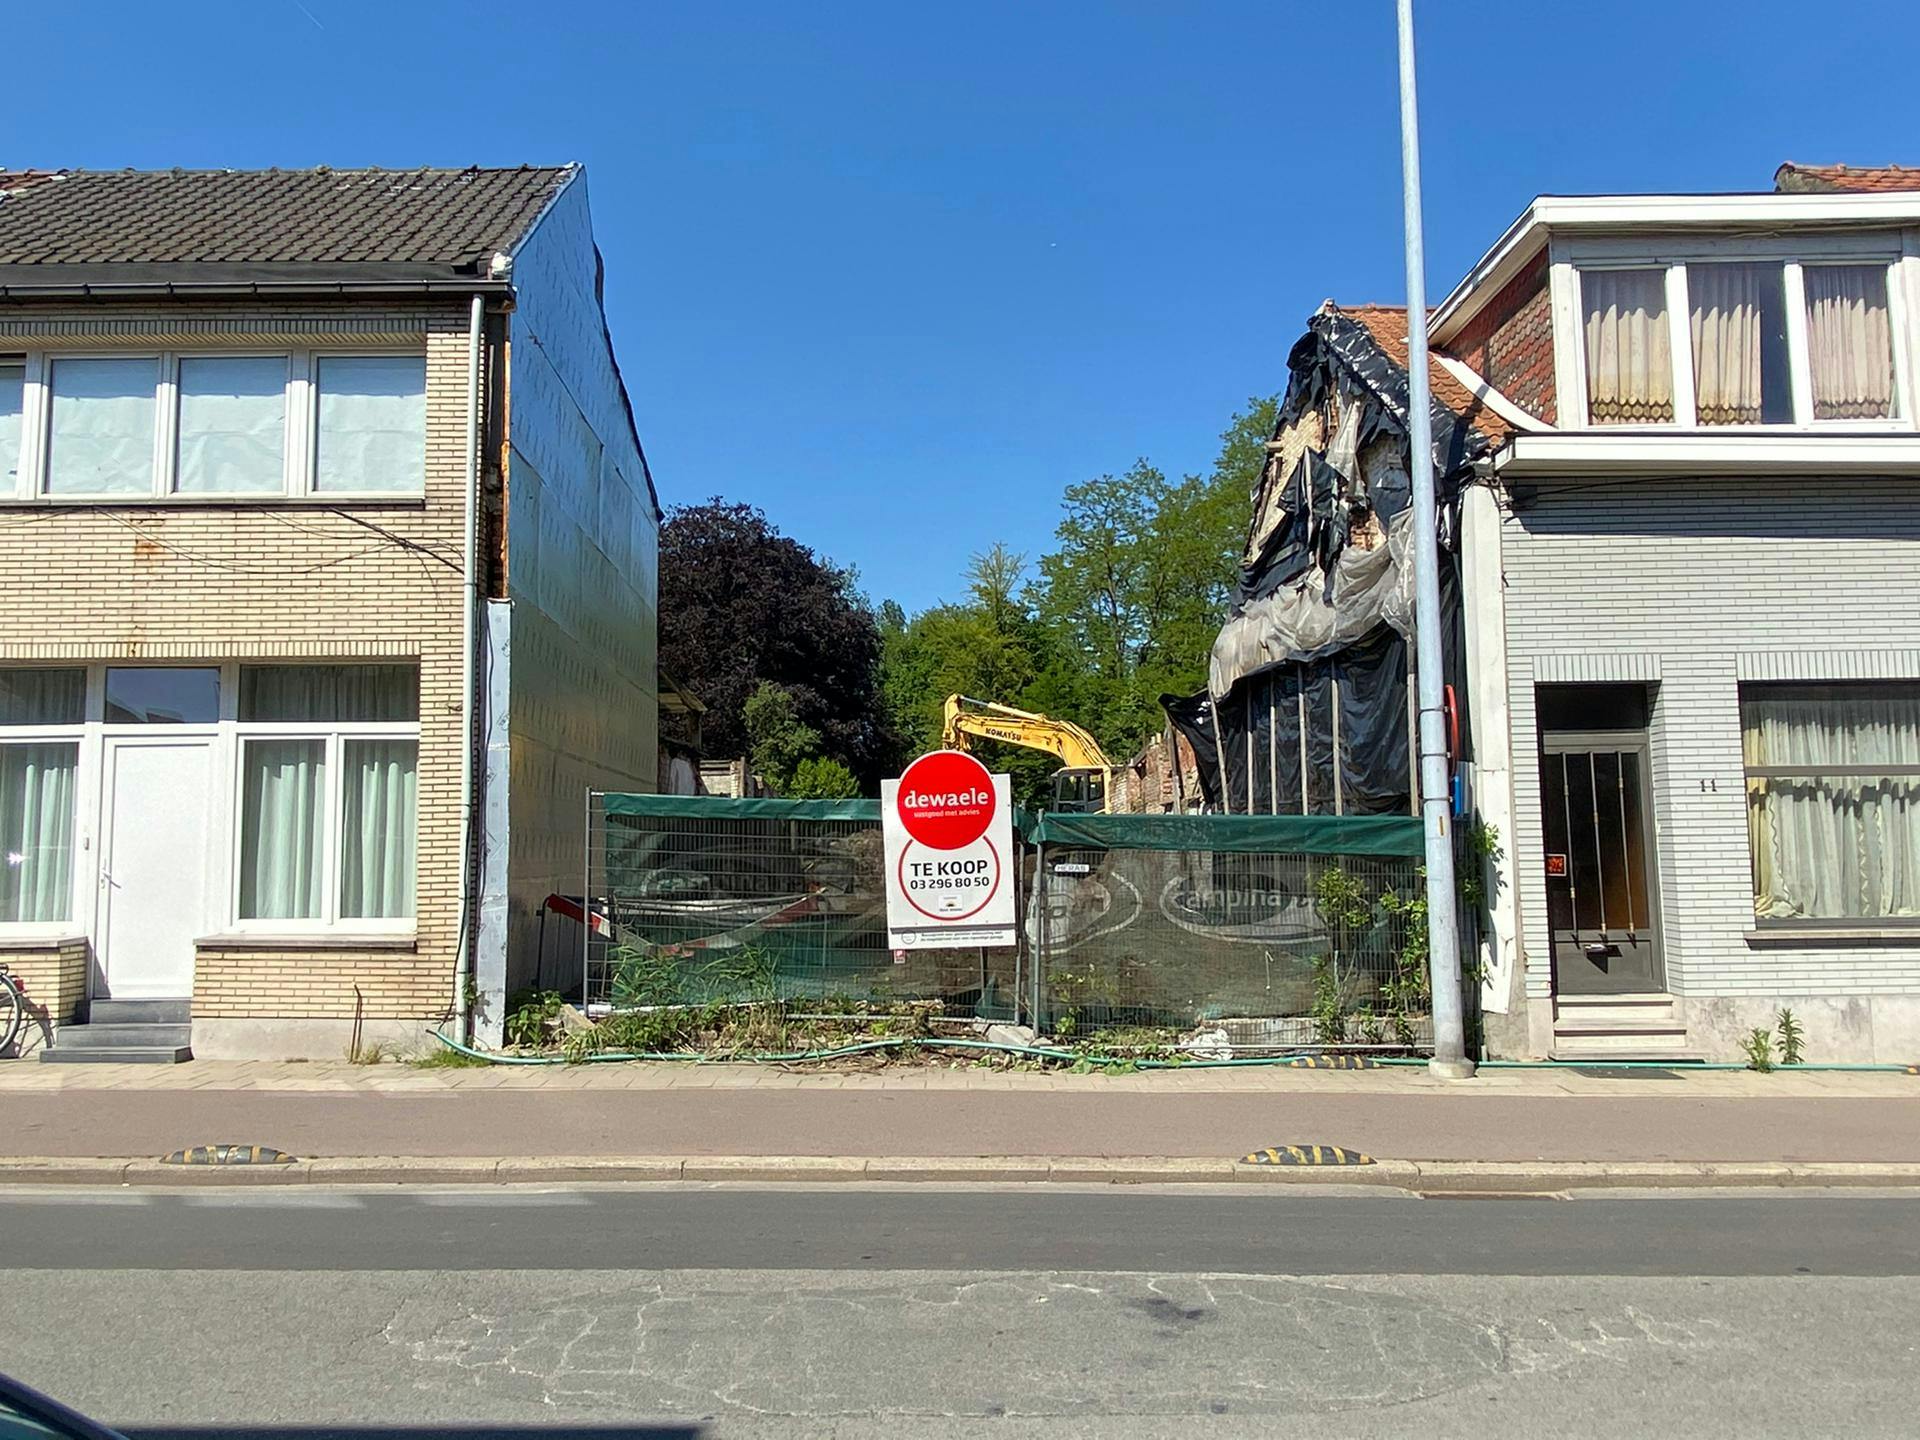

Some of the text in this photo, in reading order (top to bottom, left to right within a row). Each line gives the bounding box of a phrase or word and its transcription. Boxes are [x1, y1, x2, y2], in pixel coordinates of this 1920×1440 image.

[985, 727, 1022, 741] KOMATSU
[1700, 778, 1717, 793] 11
[904, 787, 989, 809] dewaele
[910, 859, 988, 877] TE KOOP
[910, 876, 990, 890] 03 296 80 50
